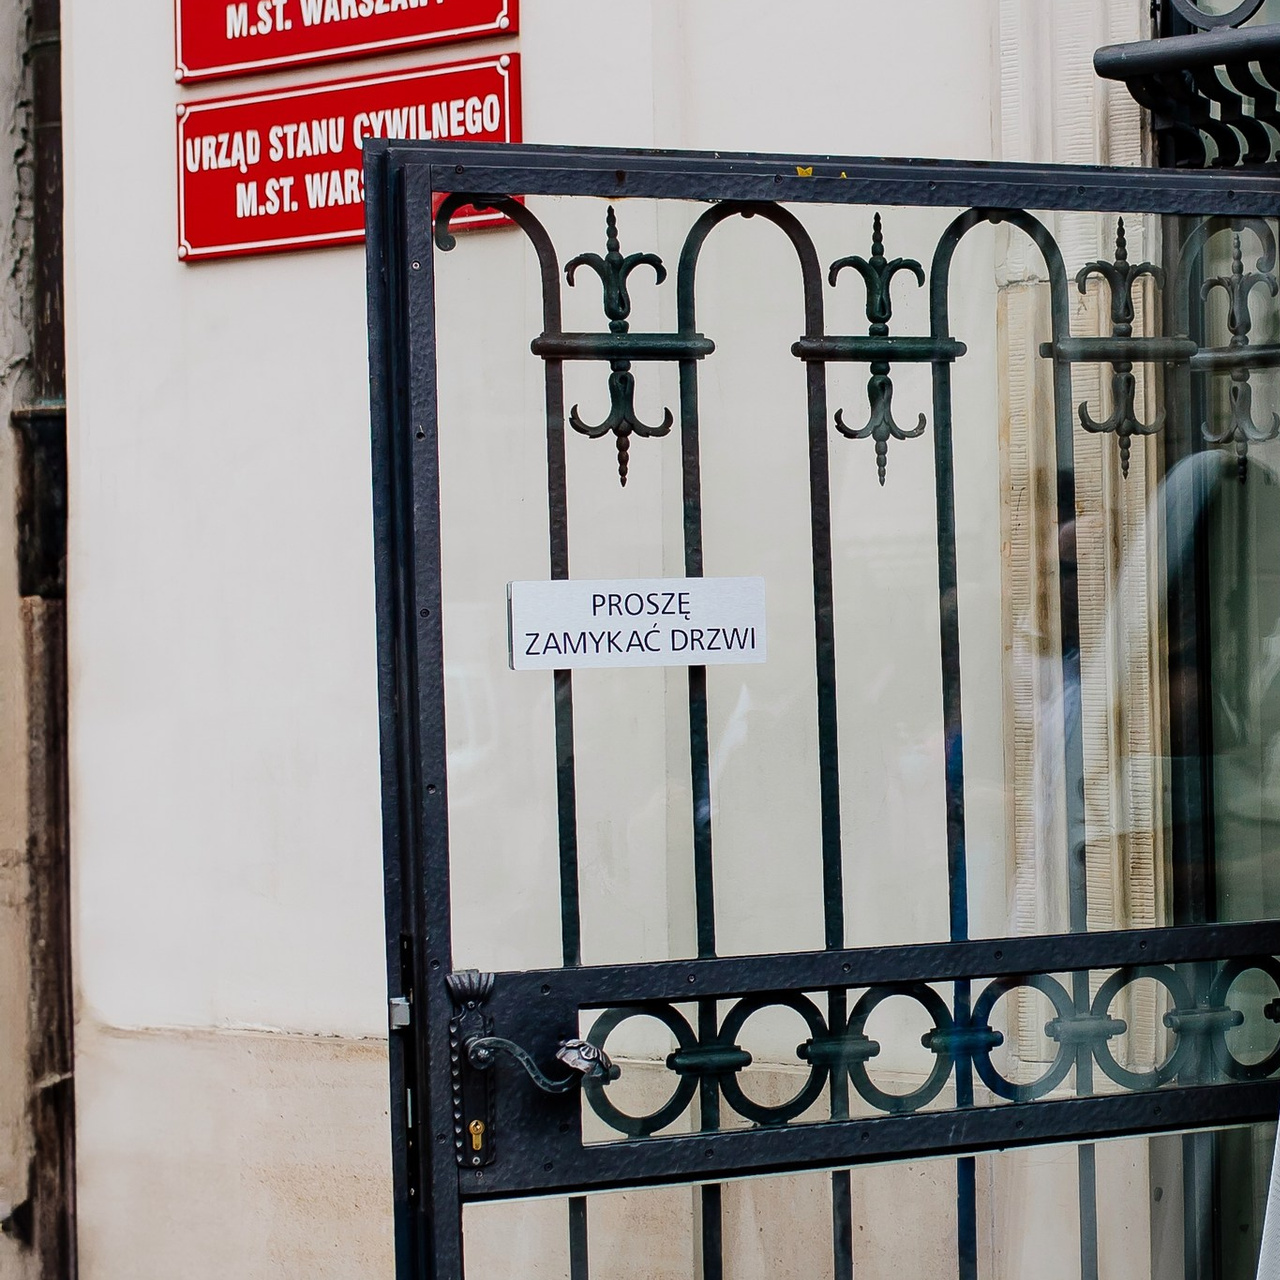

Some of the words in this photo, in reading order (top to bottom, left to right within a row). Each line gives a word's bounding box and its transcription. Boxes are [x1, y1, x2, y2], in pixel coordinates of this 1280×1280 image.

[185, 129, 261, 174] URZĄD
[268, 116, 345, 163] STANU
[354, 94, 499, 149] CYWILNEGO
[236, 176, 298, 217] M.ST.
[592, 592, 690, 620] PROSZĘ
[525, 622, 661, 655] ZAMYKAĆ
[671, 626, 756, 652] DRZWI
